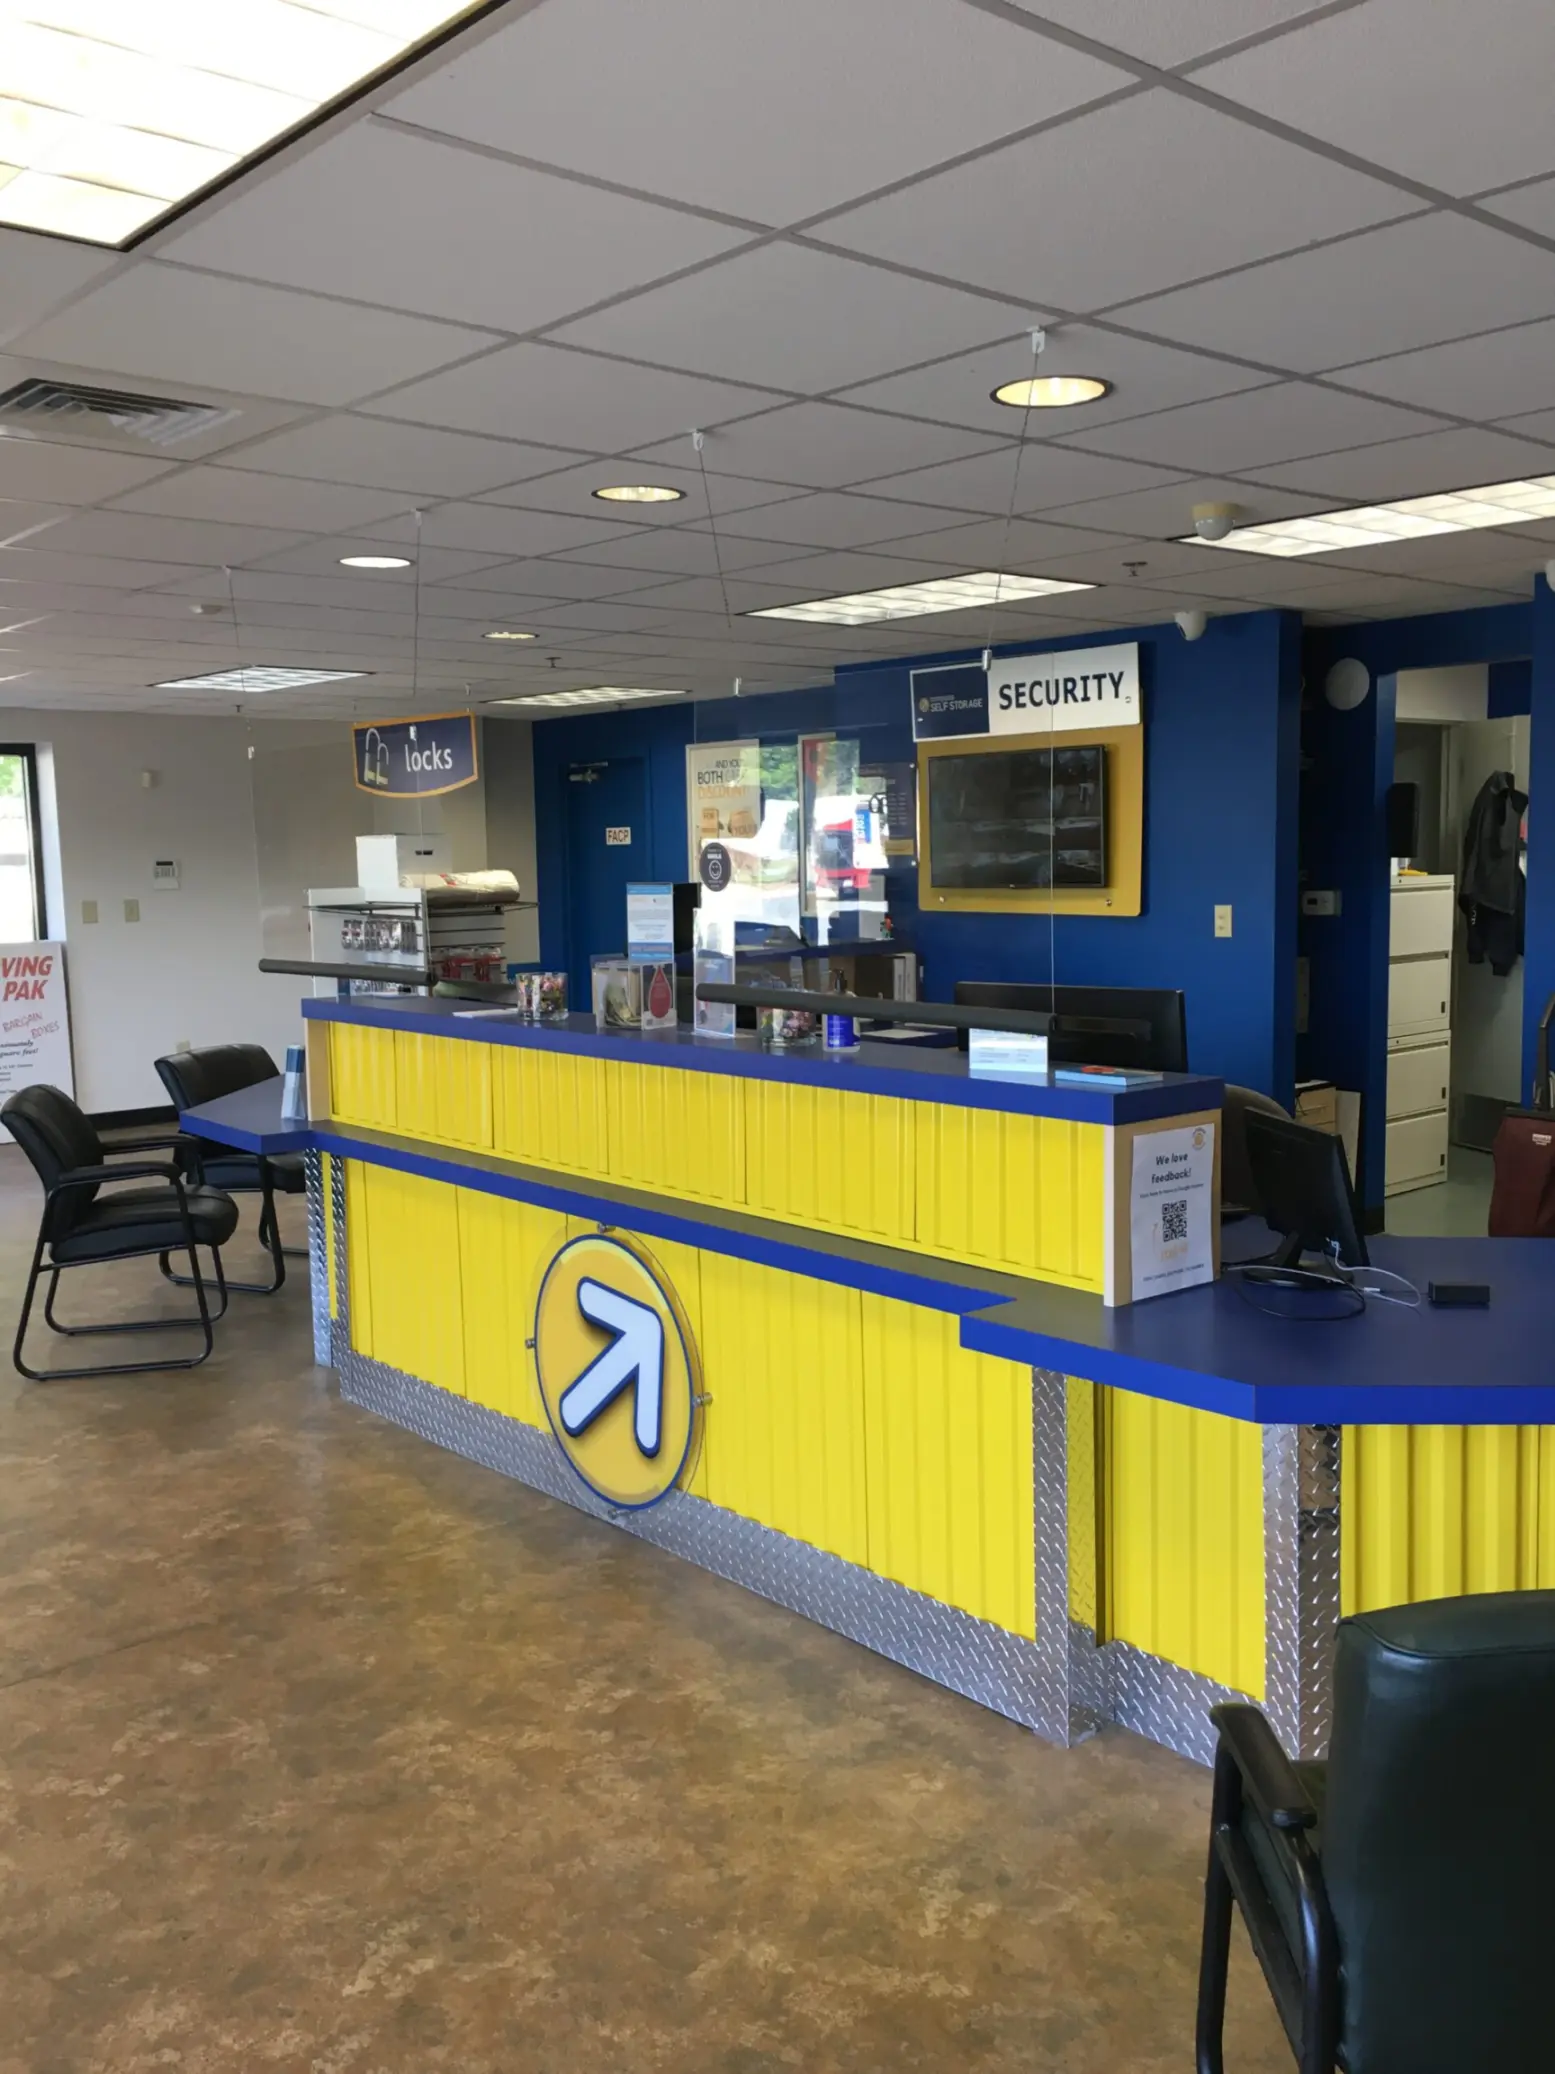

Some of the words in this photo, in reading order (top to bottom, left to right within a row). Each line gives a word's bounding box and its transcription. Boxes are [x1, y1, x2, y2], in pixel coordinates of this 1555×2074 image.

[998, 670, 1125, 711] SECURITY
[930, 702, 949, 712] SELF
[949, 698, 983, 710] STORAGE
[404, 740, 453, 772] locks
[697, 770, 724, 785] BOTH
[2, 956, 53, 978] VING
[3, 979, 48, 1001] PAK
[1155, 1155, 1170, 1166] We
[1171, 1152, 1188, 1163] love
